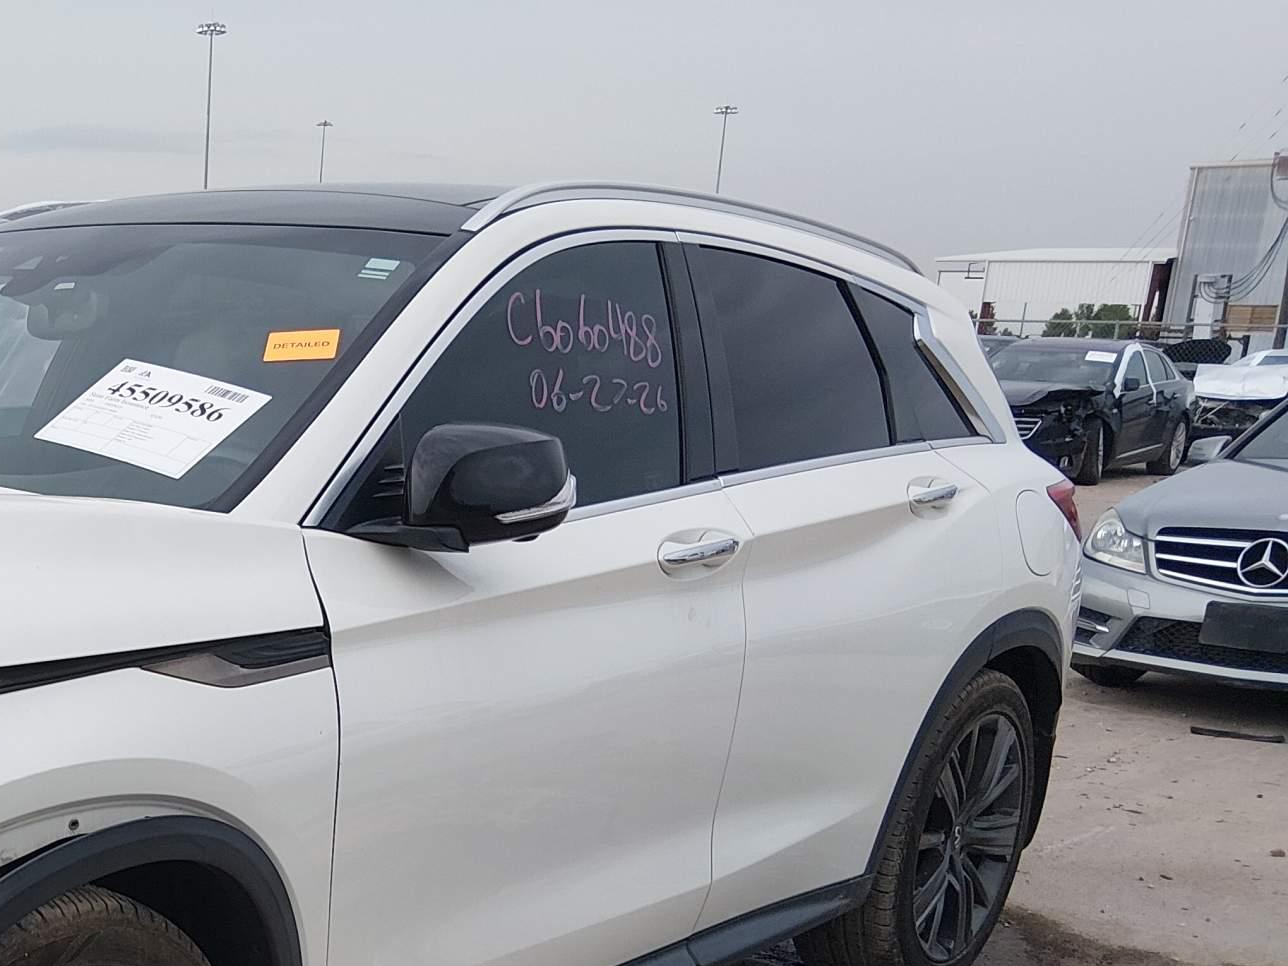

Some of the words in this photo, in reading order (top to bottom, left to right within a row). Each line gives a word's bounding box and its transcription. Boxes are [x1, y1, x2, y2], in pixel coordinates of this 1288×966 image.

[273, 340, 330, 350] DETAILED
[107, 380, 232, 423] 45509586
[529, 367, 668, 415] 06-27-26
